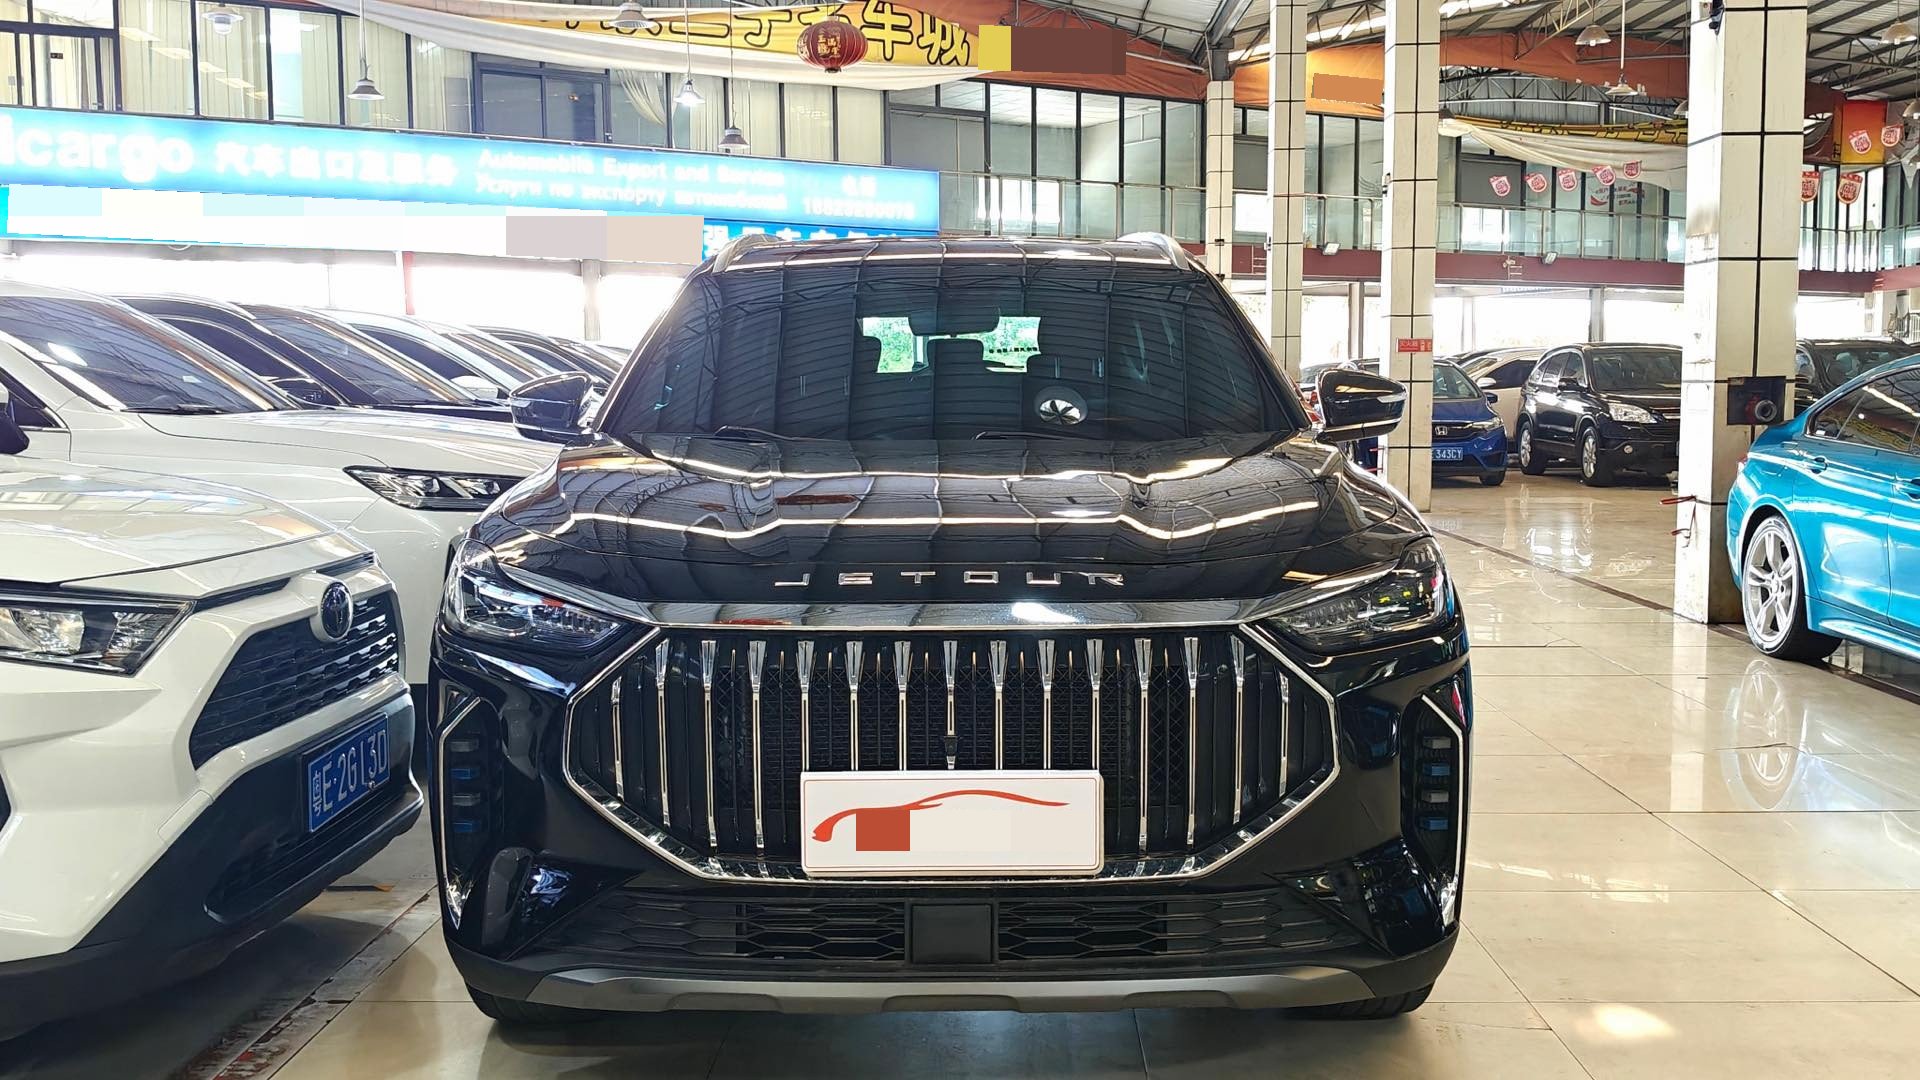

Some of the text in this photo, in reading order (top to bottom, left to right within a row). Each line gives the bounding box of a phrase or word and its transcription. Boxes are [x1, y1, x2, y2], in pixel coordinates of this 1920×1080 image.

[603, 157, 667, 182] Export
[674, 164, 710, 183] and
[1432, 448, 1462, 459] 343CY
[774, 571, 1125, 587] JETOUR
